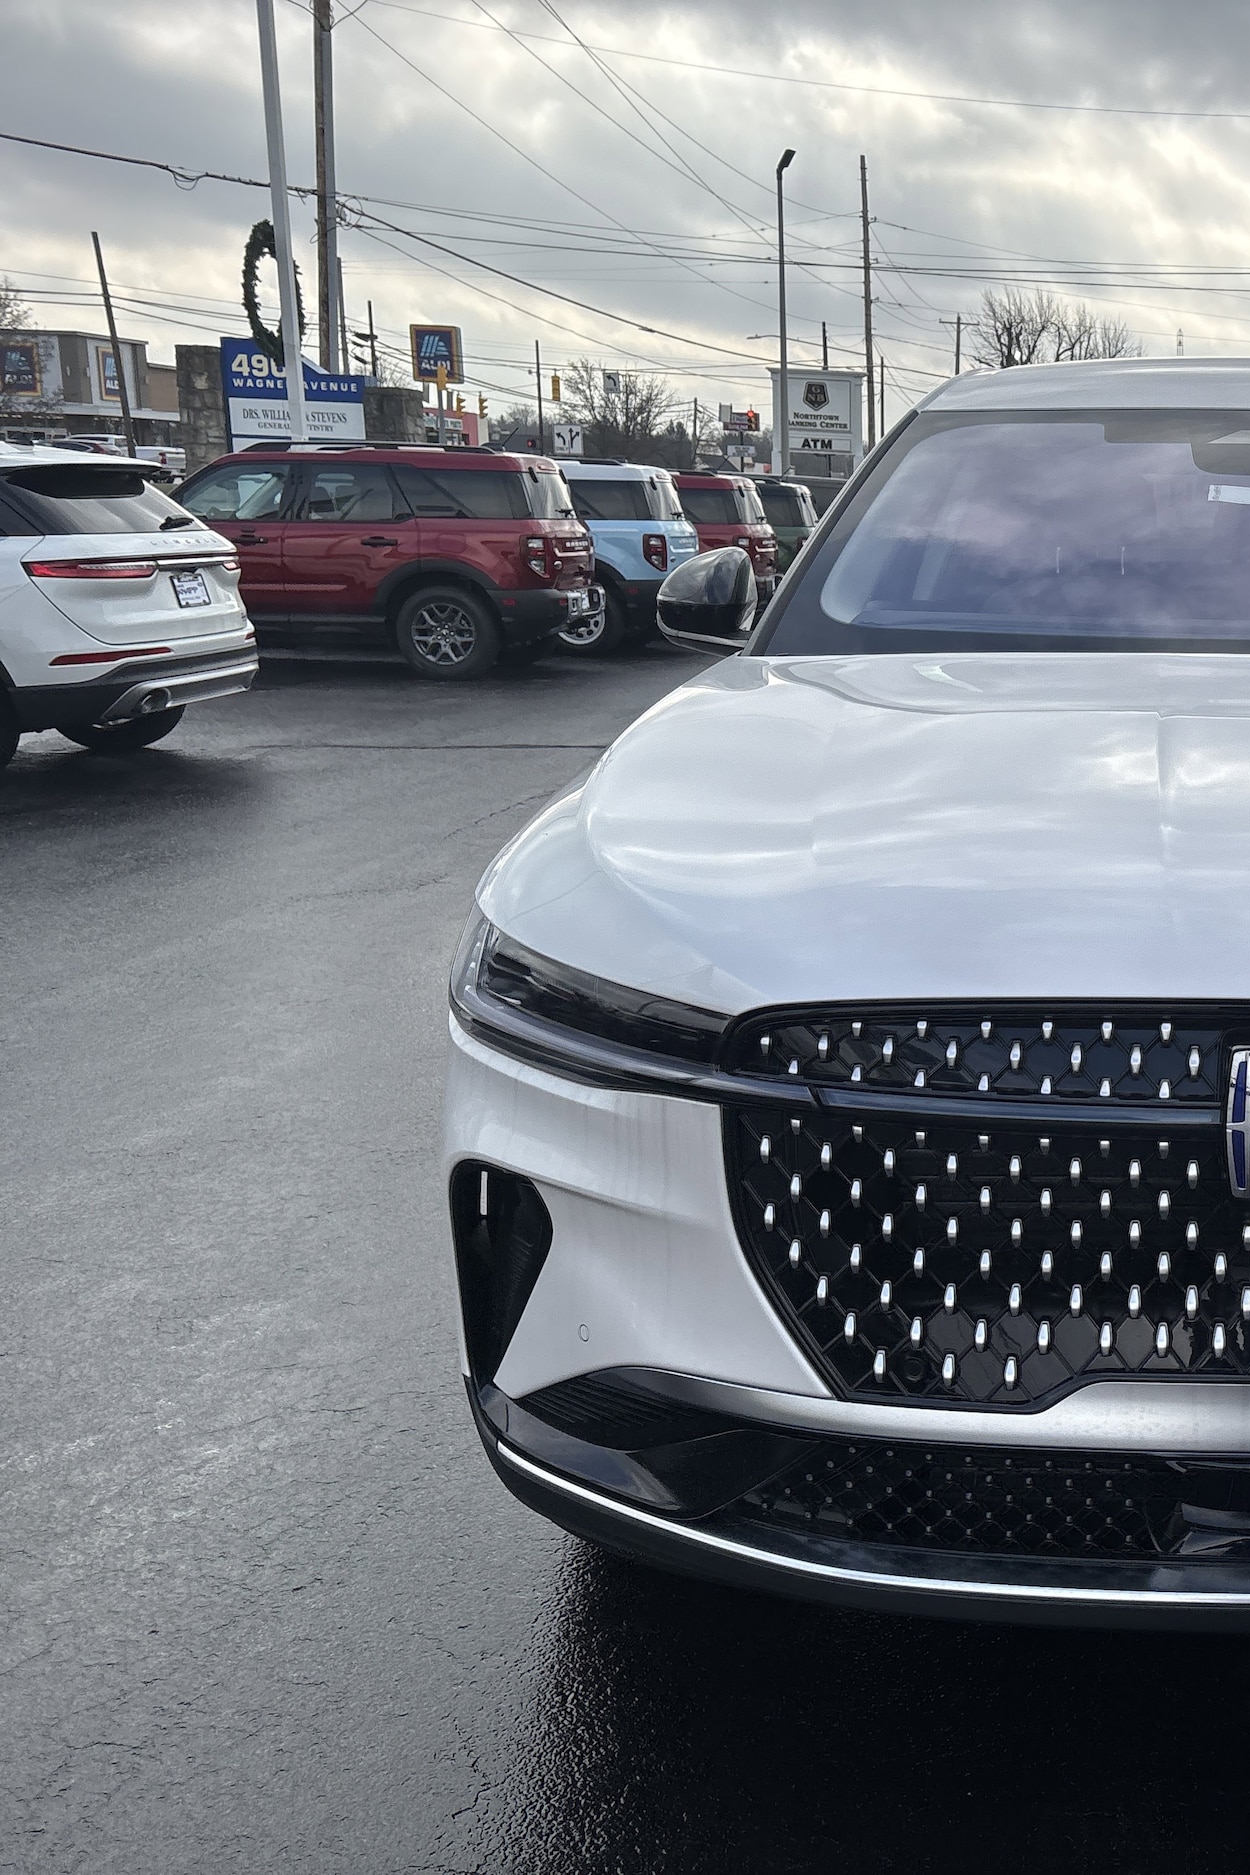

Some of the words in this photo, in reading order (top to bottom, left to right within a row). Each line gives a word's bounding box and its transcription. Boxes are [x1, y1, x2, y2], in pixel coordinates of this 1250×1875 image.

[421, 359, 450, 371] ALDI
[105, 379, 120, 390] ALD
[233, 378, 284, 389] WAGNE
[303, 381, 357, 392] AVENUE
[243, 408, 260, 419] DRS.
[261, 409, 291, 421] WILLIA
[311, 412, 347, 423] STEVENS
[802, 438, 832, 449] ATM
